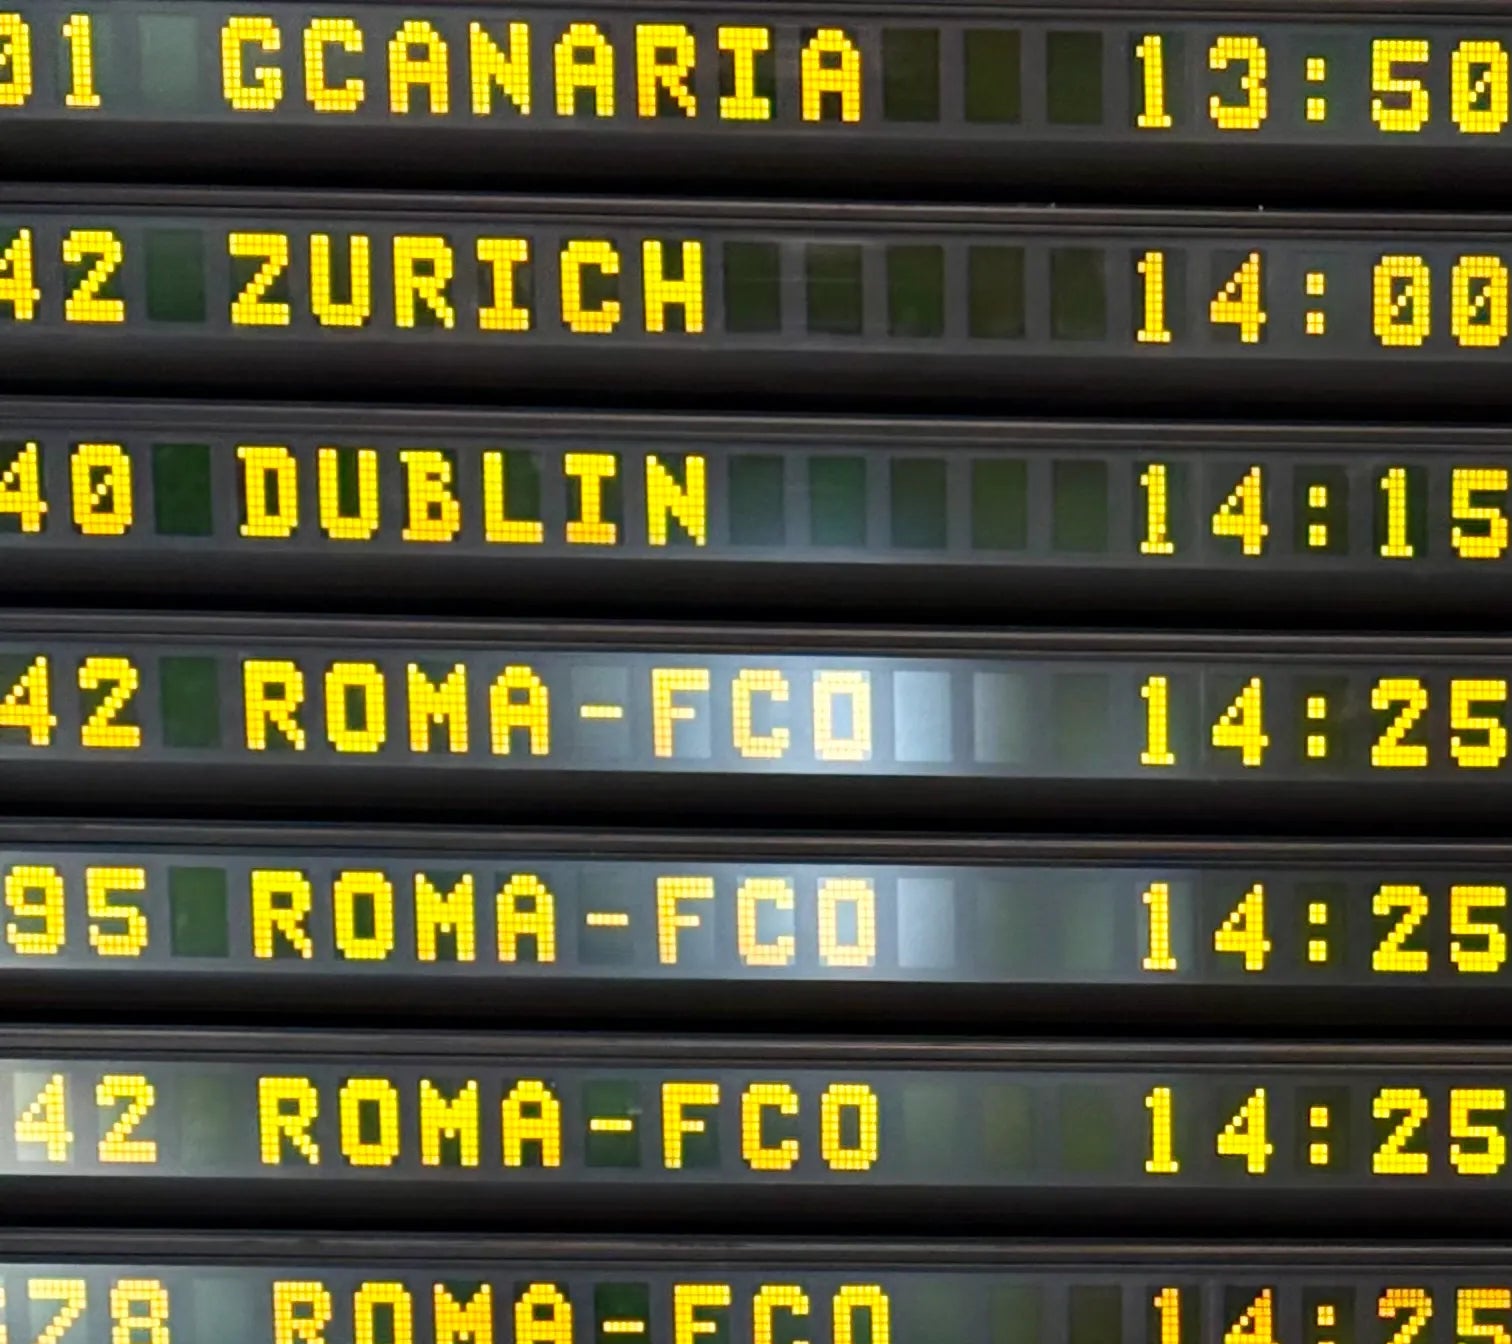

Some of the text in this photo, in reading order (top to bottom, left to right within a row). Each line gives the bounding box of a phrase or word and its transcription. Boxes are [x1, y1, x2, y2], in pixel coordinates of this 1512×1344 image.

[221, 17, 860, 121] GCANARIA
[1136, 36, 1508, 133] 13:50
[0, 229, 124, 322] 42
[229, 233, 703, 333] ZURICH
[1138, 252, 1508, 346] 14:00
[0, 443, 132, 534] 40
[237, 447, 706, 546] DUBLIN
[1141, 465, 1508, 558] 14:15
[0, 656, 141, 748] 42
[244, 660, 865, 756] ROMA-FCO
[1141, 676, 1507, 767] 14:25
[4, 865, 148, 957] 95
[252, 870, 874, 965] ROMA-FCO
[1142, 883, 1506, 972] 14:25
[16, 1074, 158, 1164] 42
[259, 1077, 878, 1170] ROMA-FCO
[1146, 1088, 1505, 1174] 14:25
